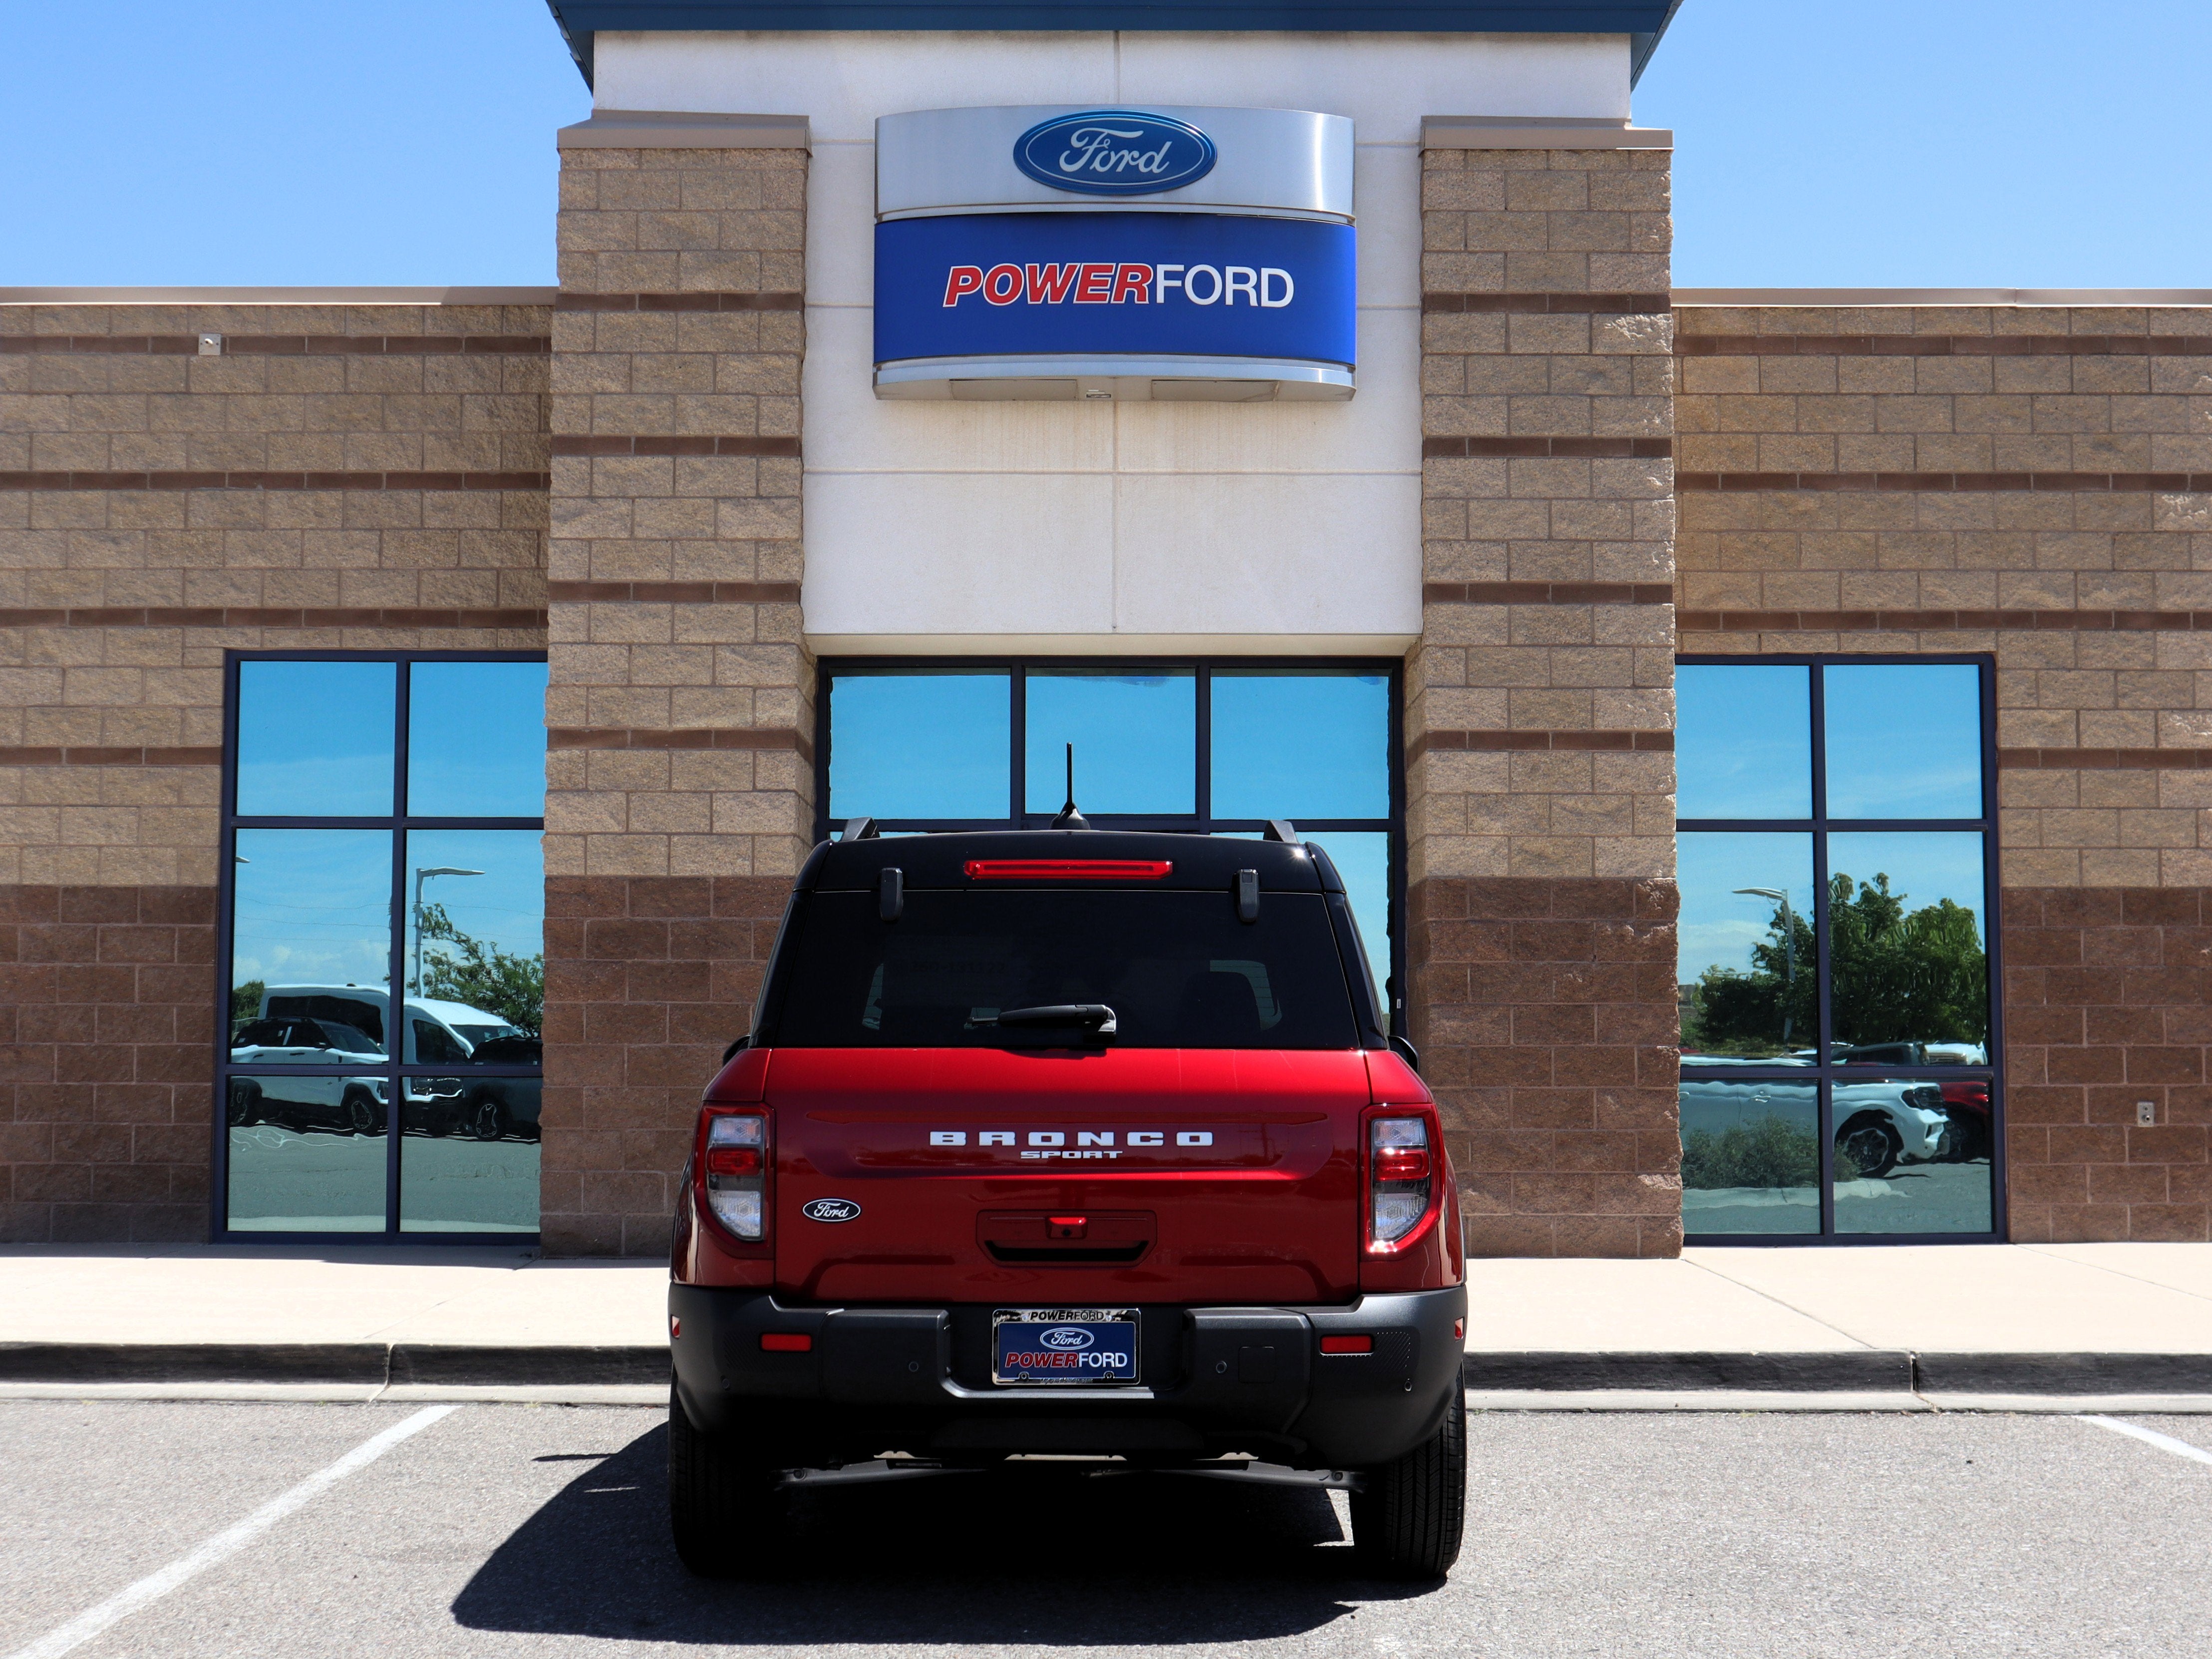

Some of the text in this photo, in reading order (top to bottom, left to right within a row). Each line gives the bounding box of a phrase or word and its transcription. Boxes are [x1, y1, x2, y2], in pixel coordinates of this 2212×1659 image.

[1059, 127, 1172, 174] Ford
[943, 263, 1294, 308] POWERFORD
[930, 1131, 1213, 1146] BRONCO
[814, 1202, 849, 1218] Ford
[1050, 1331, 1083, 1345] Ford
[1005, 1352, 1128, 1368] POWERFORD
